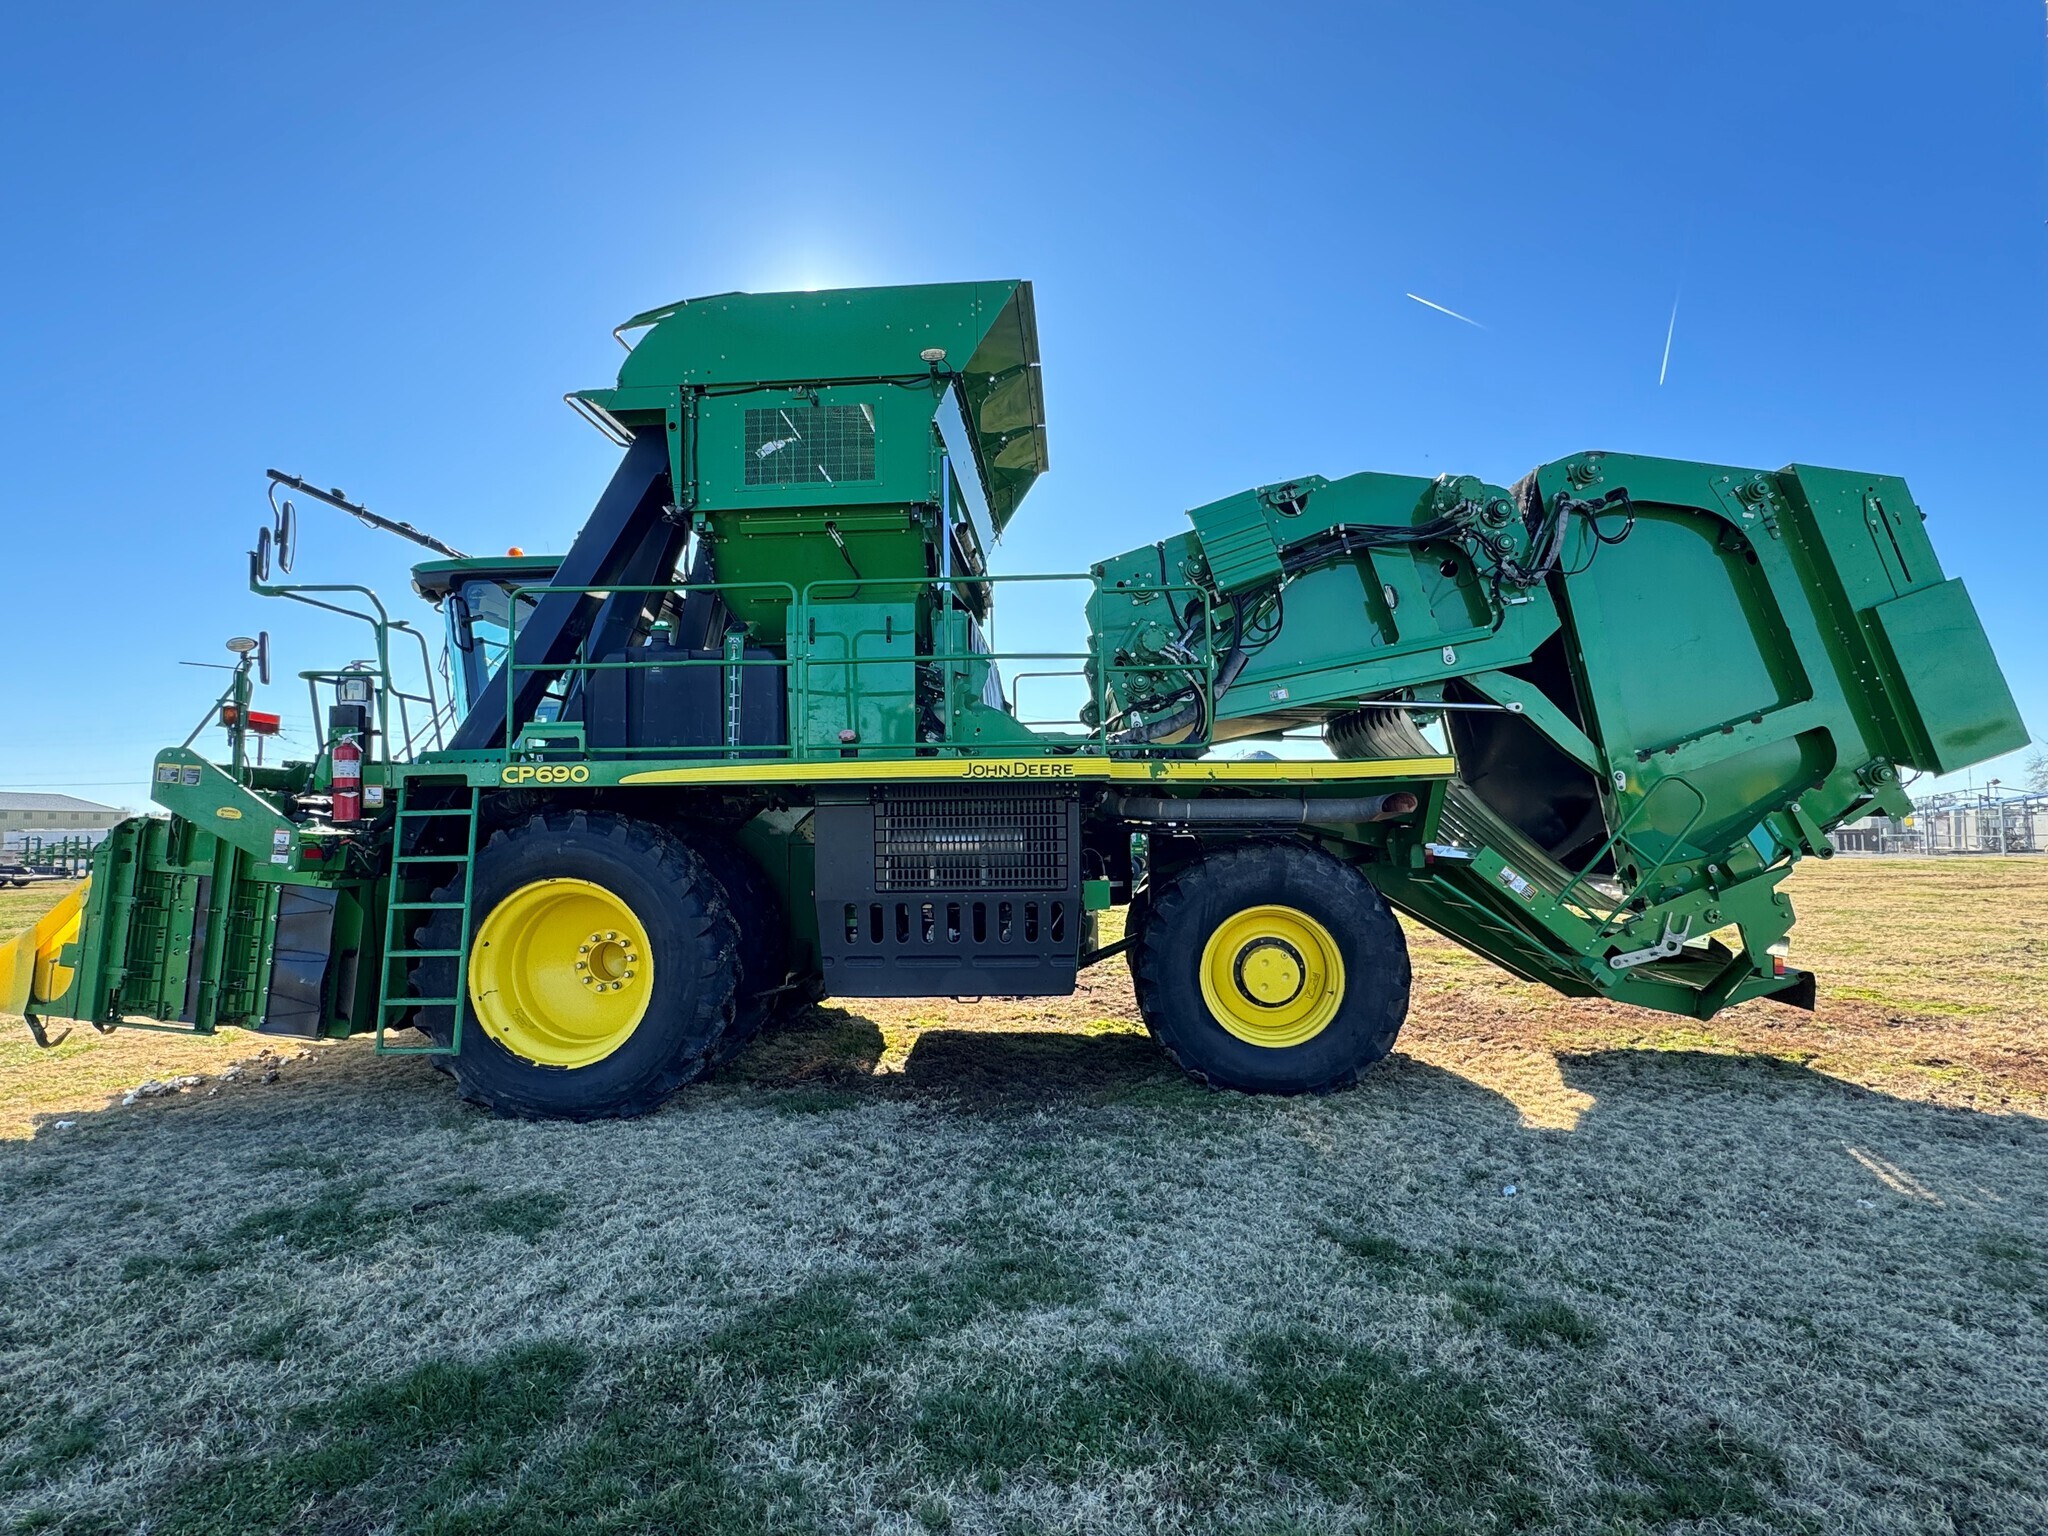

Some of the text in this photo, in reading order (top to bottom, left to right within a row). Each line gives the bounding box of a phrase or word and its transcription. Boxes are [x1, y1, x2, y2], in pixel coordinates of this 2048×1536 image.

[502, 765, 590, 784] CP690
[963, 763, 1074, 776] JOHN DEERE
